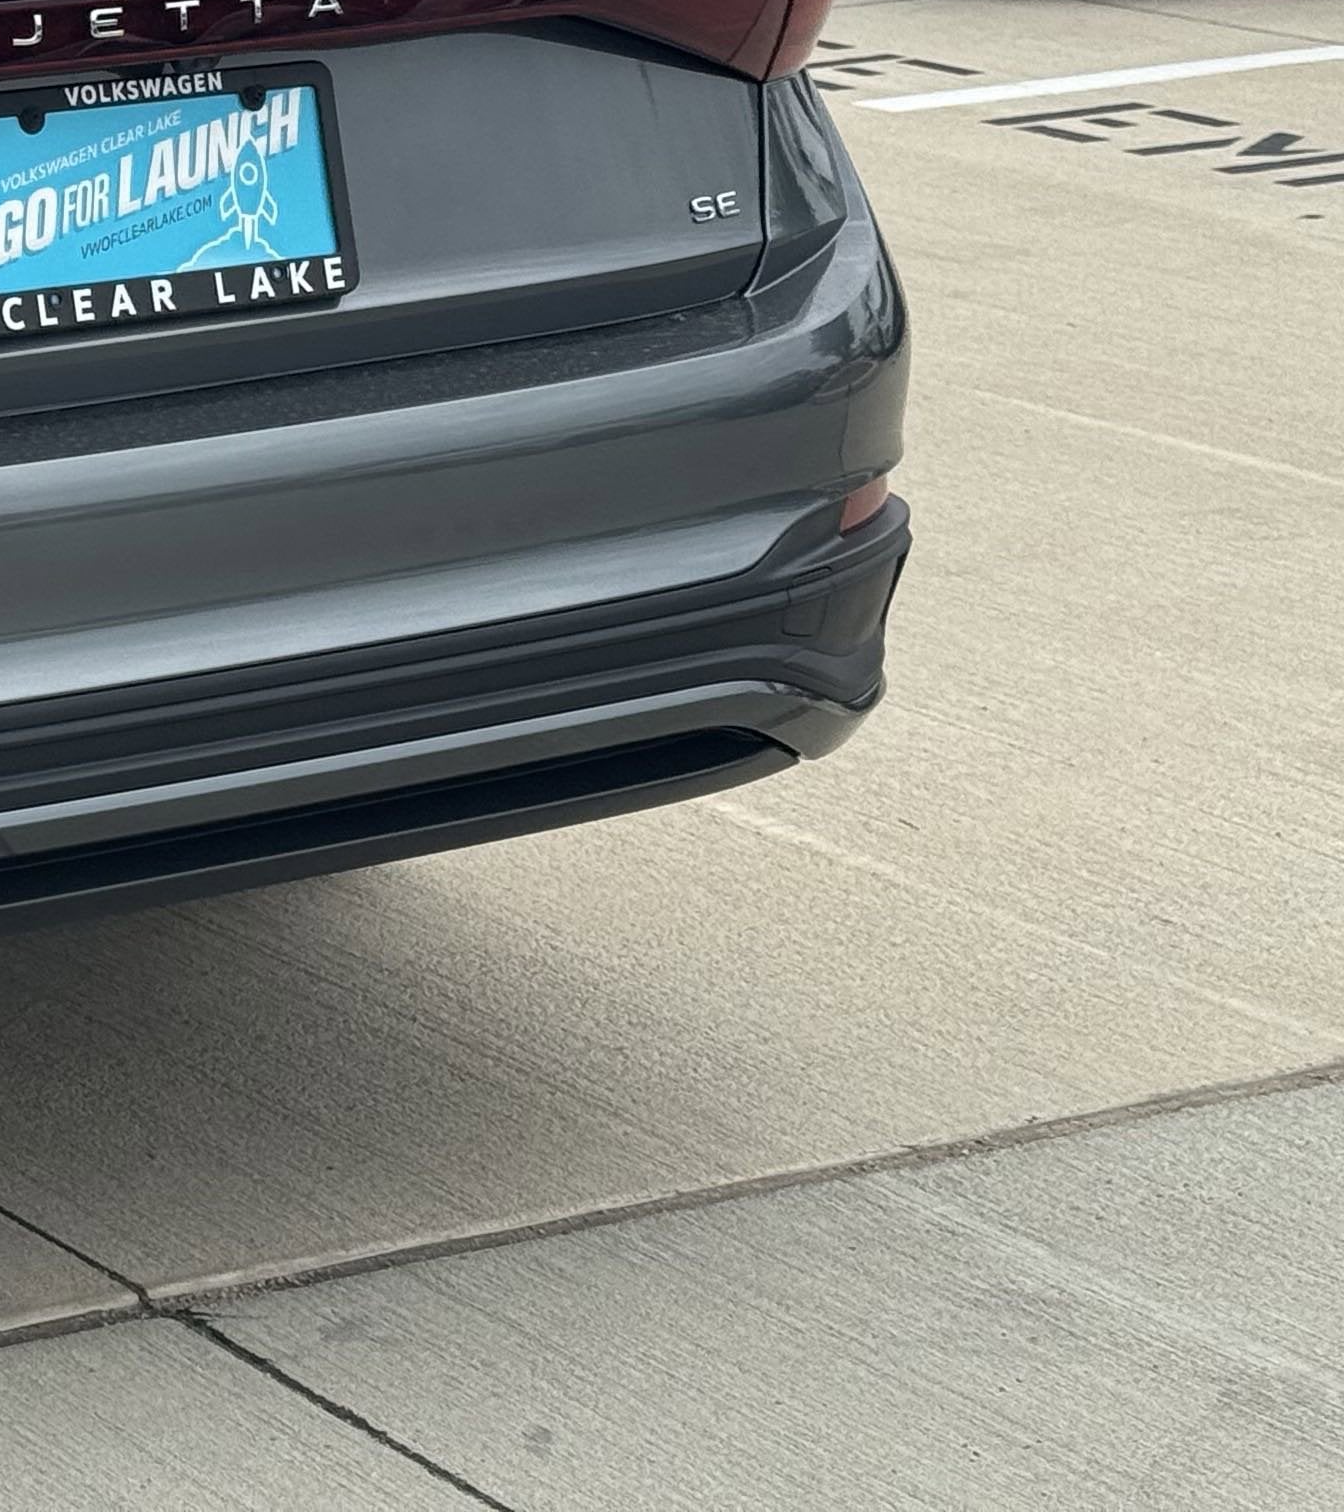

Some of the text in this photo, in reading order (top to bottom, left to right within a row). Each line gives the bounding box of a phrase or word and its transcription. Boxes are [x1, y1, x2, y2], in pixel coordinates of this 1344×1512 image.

[64, 71, 224, 107] VOLKSWAGEN
[0, 108, 183, 193] VOLKSWAGEN CLEAR LAKE
[62, 172, 111, 235] FOR
[116, 87, 303, 218] LAUNCH
[80, 194, 214, 260] VWOFCLEARLAKE.COM
[690, 190, 741, 223] SE
[1, 256, 347, 332] CLEAR LAKE
